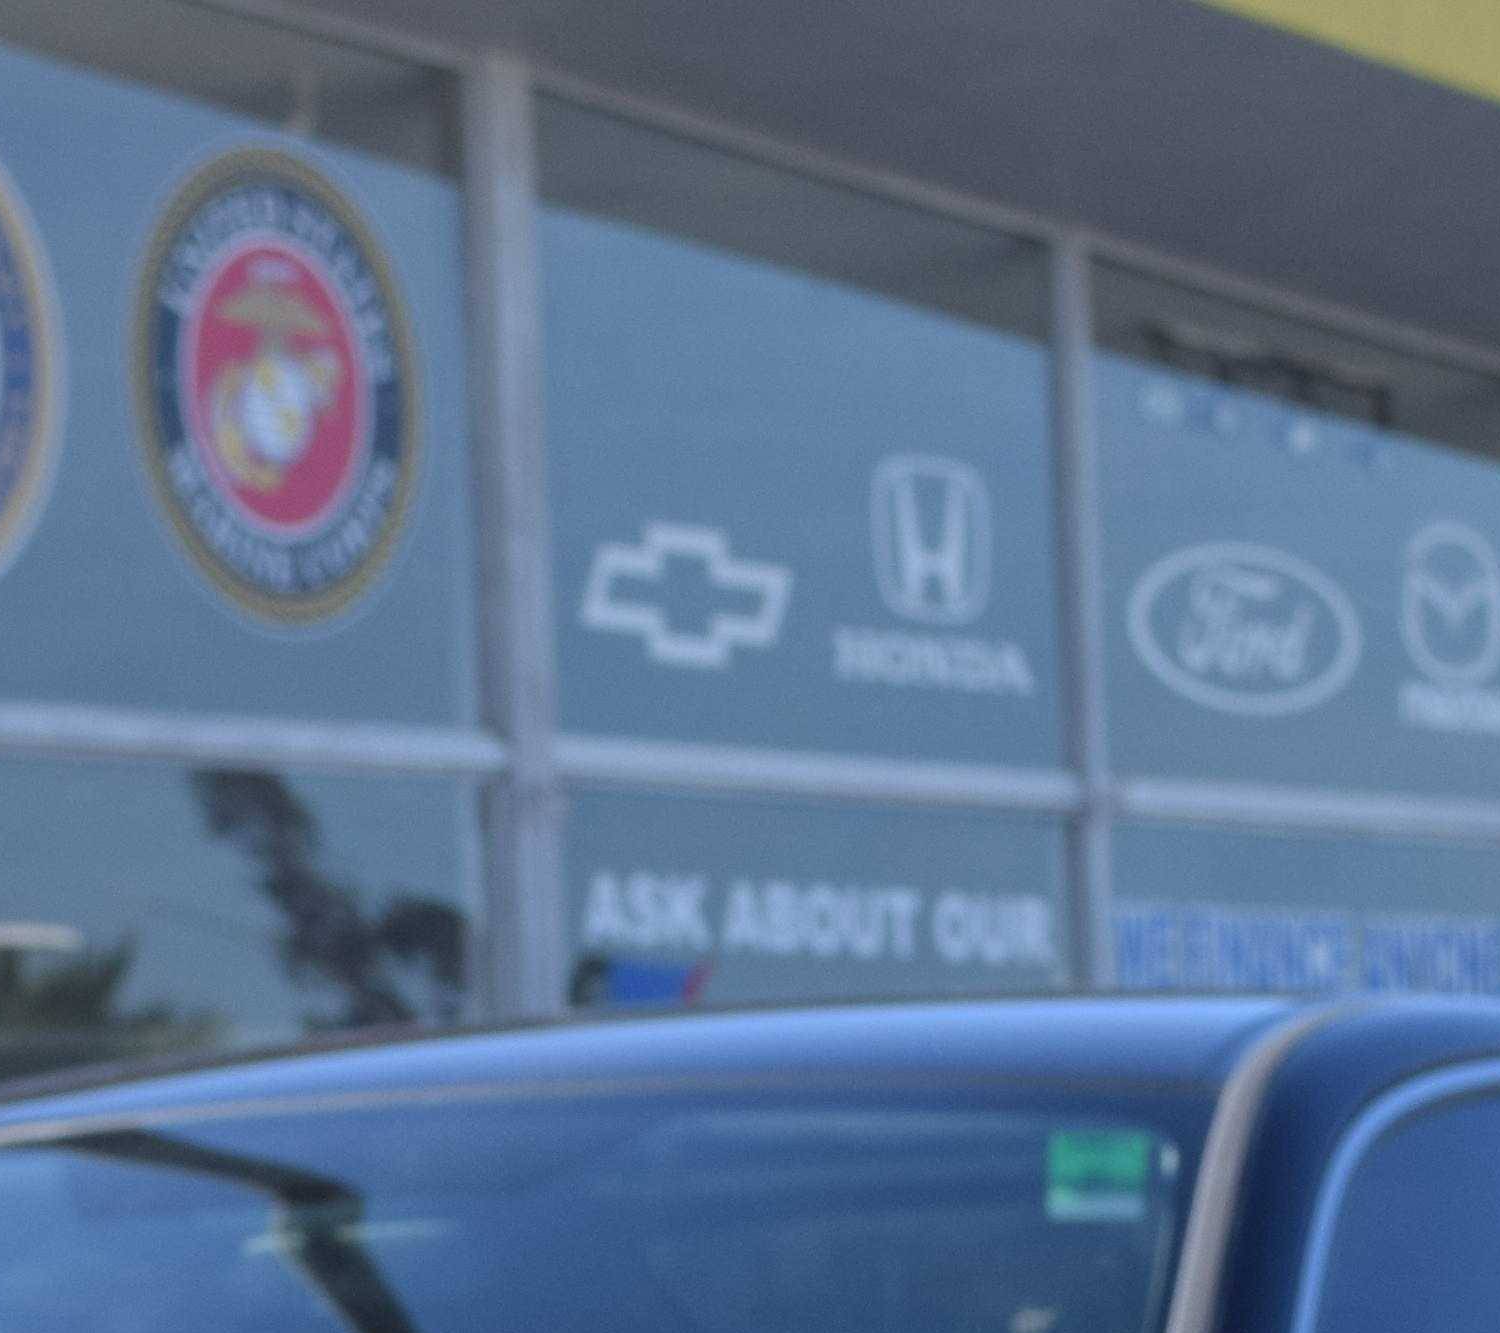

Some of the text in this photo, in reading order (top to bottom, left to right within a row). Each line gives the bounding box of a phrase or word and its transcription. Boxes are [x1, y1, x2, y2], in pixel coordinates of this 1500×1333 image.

[833, 624, 1035, 698] HONDA
[1182, 566, 1312, 682] Ford
[584, 870, 1058, 965] ASK ABOUT OUR
